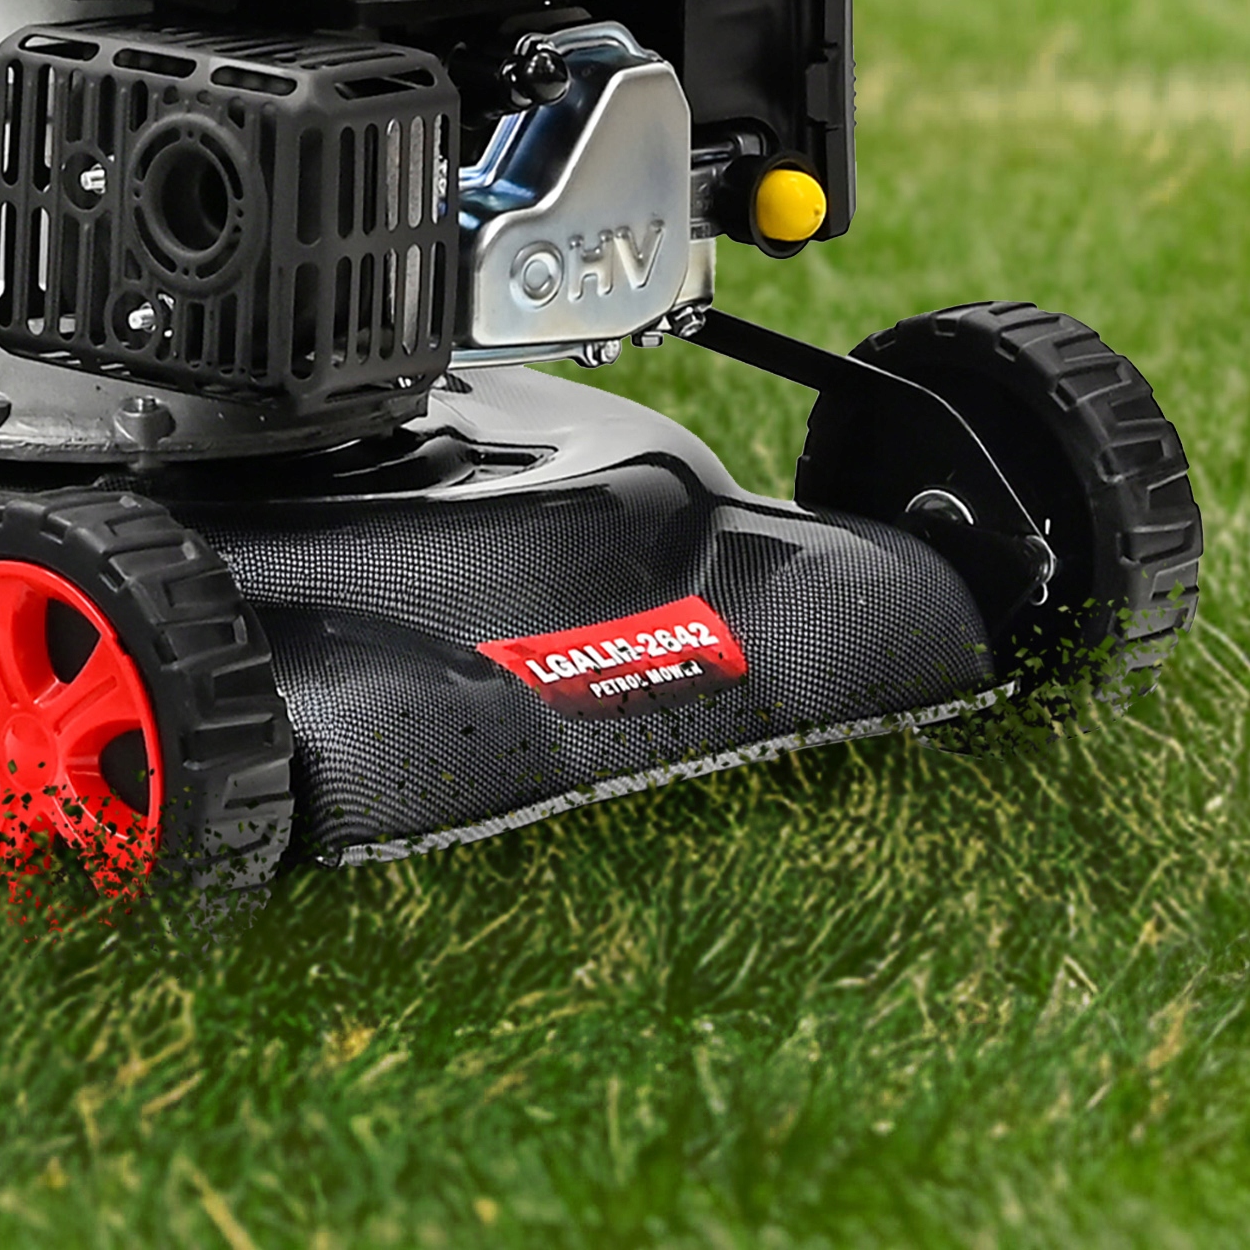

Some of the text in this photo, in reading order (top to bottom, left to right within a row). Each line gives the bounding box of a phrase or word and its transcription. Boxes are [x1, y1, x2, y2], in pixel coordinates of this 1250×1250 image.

[510, 218, 666, 312] OHV
[525, 622, 720, 684] LGALM-2642
[589, 672, 649, 699] PETROL
